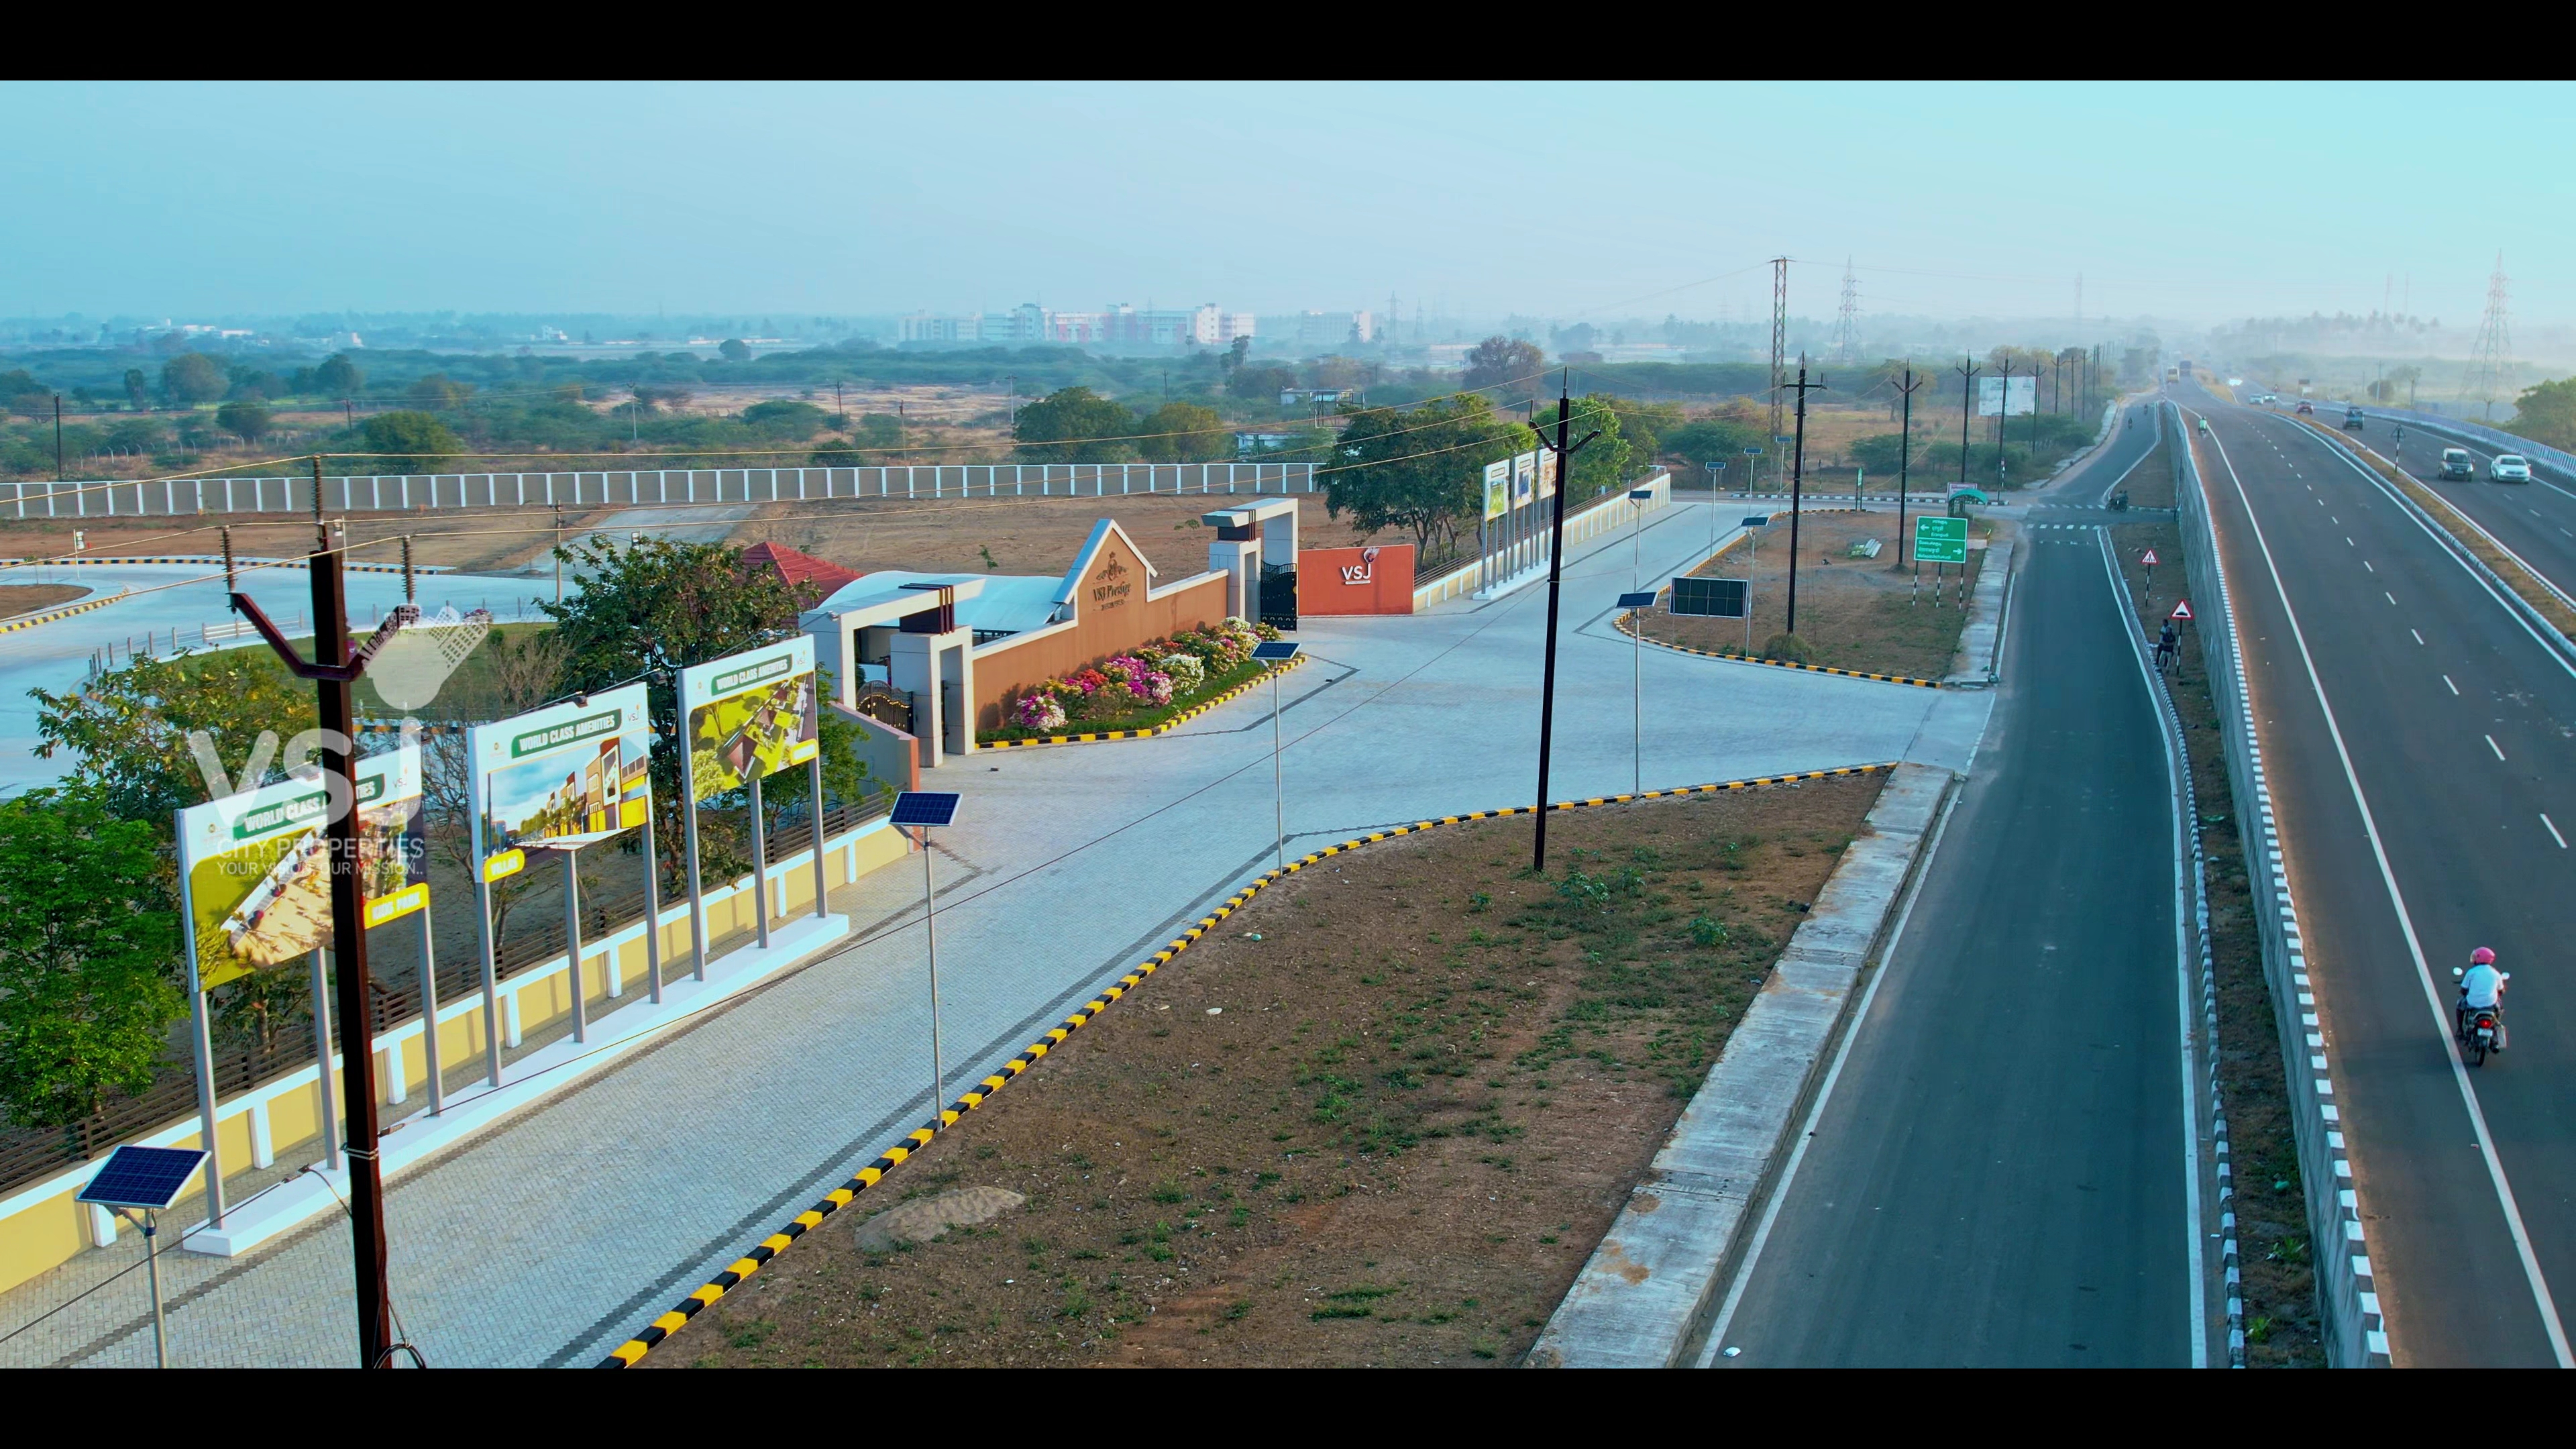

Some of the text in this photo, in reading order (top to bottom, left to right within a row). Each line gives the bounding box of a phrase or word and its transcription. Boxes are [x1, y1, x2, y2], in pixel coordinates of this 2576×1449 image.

[1342, 563, 1371, 580] VSJ
[716, 659, 788, 690] WORLD CLASS AMENITIES
[519, 714, 615, 752] WORLD CLASS AMENITIES
[244, 807, 284, 833] WORLD
[285, 796, 320, 819] CLASS
